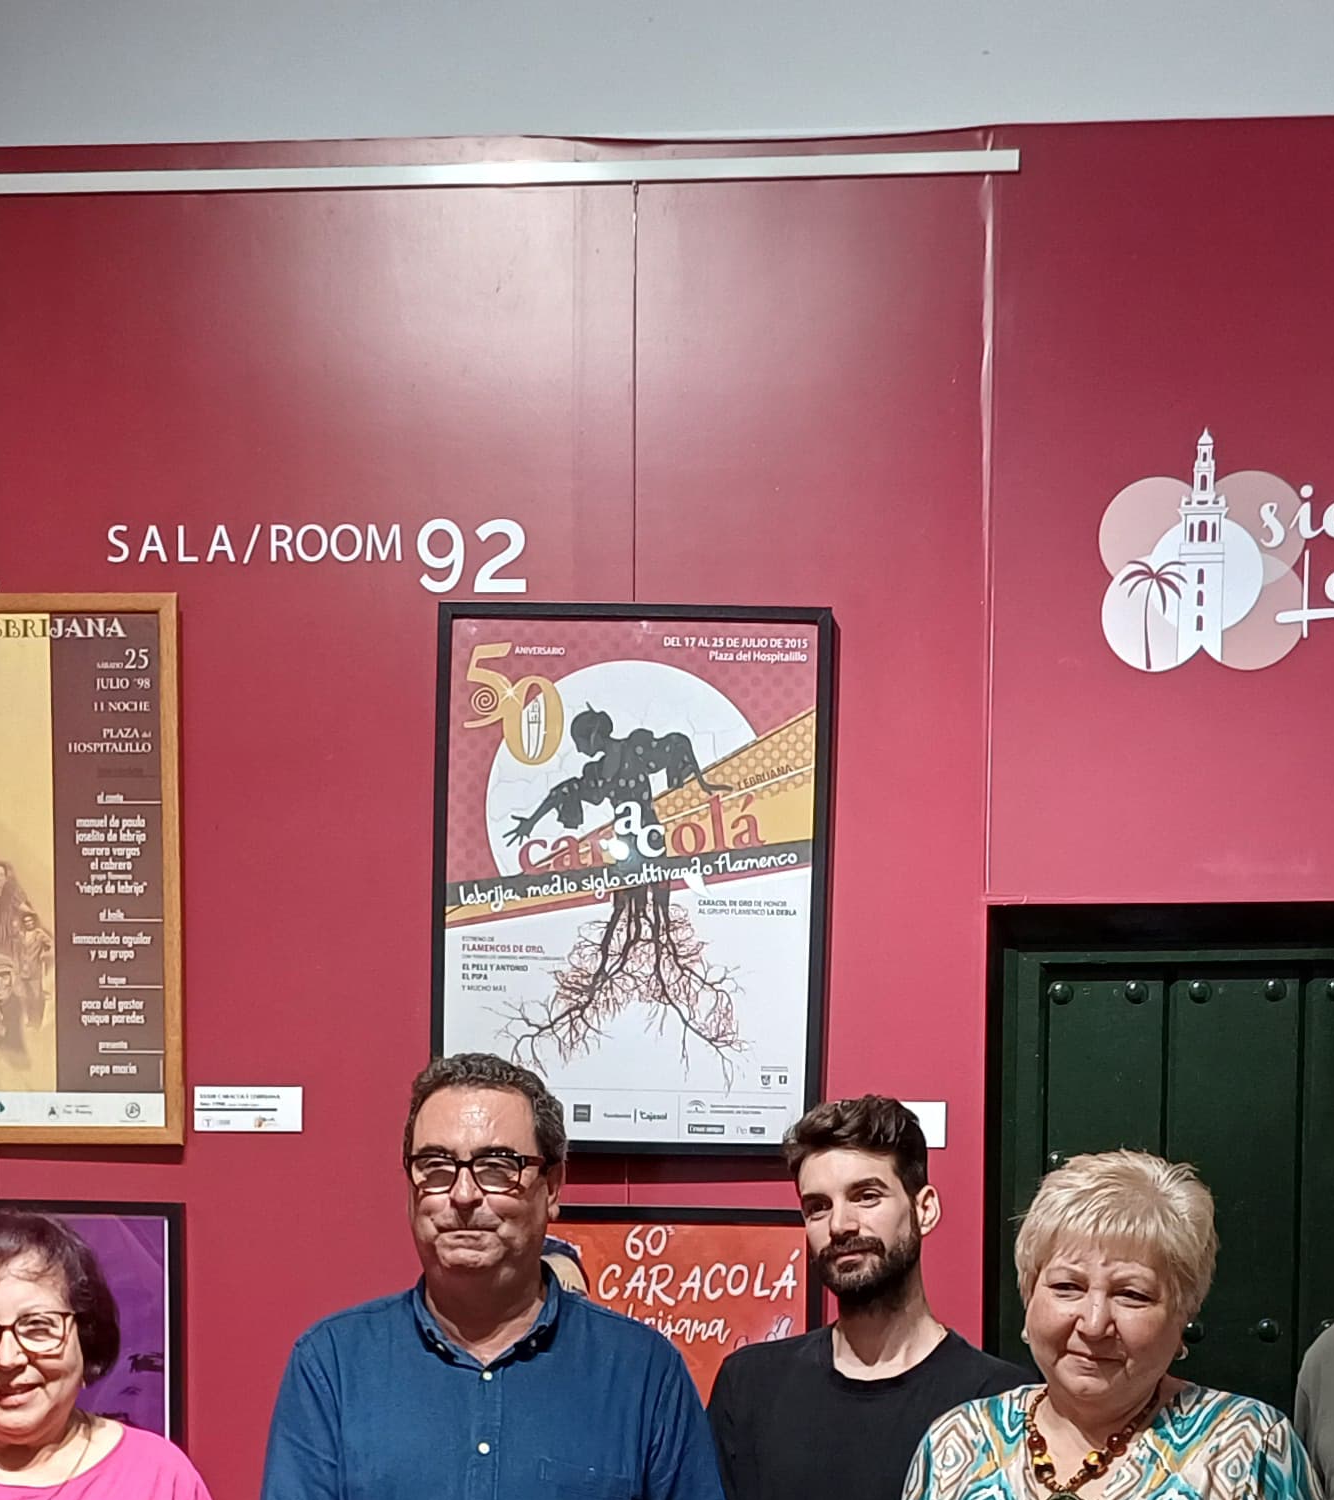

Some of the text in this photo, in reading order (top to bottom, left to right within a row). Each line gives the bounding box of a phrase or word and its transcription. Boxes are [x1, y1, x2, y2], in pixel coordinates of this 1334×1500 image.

[416, 518, 527, 593] 92
[663, 636, 808, 649] DEL 17 AL 25 DE JULIO DE 2015
[514, 645, 566, 656] ANIVERSARIO
[709, 650, 808, 664] Plaza del Hospitalillo
[124, 648, 149, 669] 25
[96, 677, 130, 690] JULIO
[94, 701, 151, 712] 11 NOCHE
[463, 642, 565, 767] 50
[102, 727, 139, 739] PLAZA
[68, 741, 152, 753] HOSPITALILLO
[75, 814, 146, 830] manuel de paula
[75, 829, 147, 845] joselito de lebrija
[111, 847, 141, 859] vargas
[526, 873, 579, 898] medio
[581, 871, 620, 899] siglo
[713, 853, 798, 874] flamenco
[105, 880, 116, 894] de
[513, 945, 523, 953] DE
[81, 999, 102, 1012] paco
[103, 996, 116, 1010] del
[111, 1011, 145, 1026] paredes
[598, 1249, 801, 1306] CARACOLÁ
